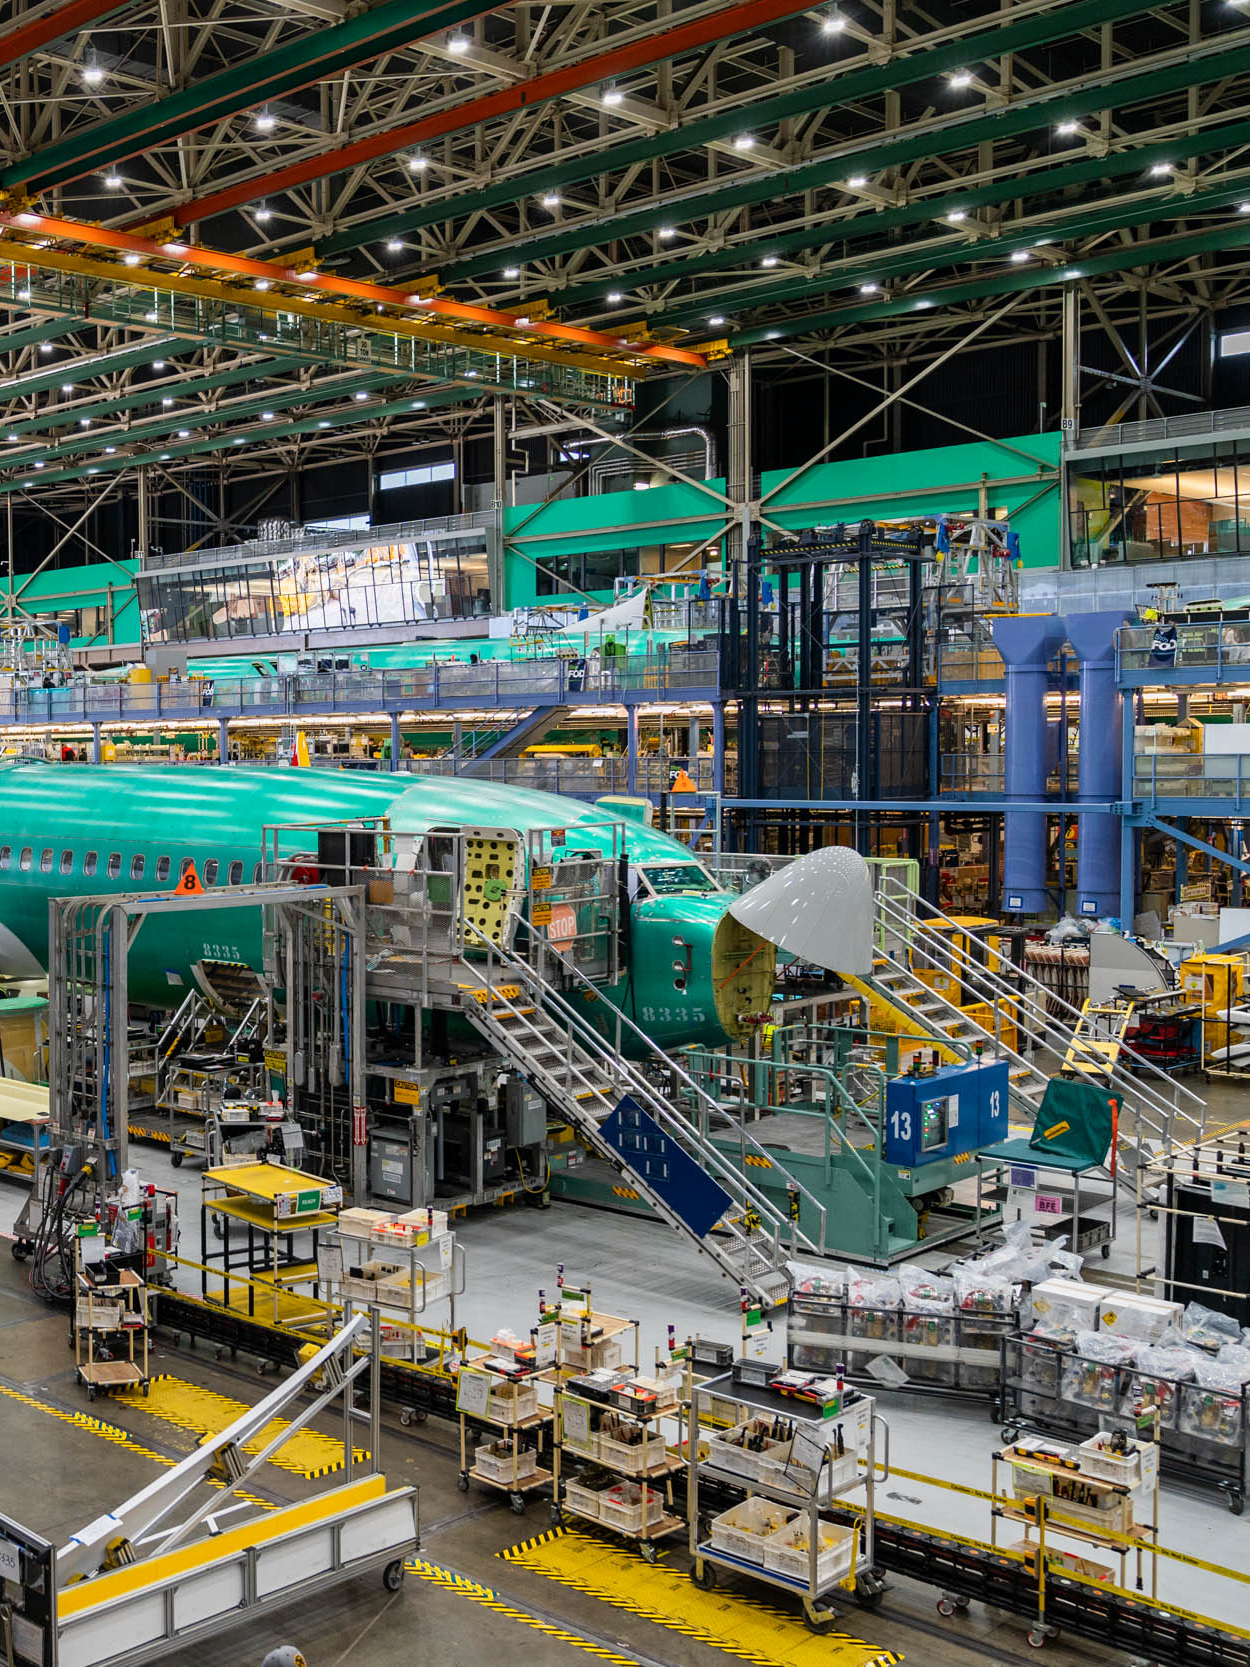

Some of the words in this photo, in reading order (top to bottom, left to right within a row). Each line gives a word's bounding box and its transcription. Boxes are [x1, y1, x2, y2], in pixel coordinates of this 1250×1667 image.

[1063, 419, 1072, 429] B9
[568, 670, 584, 678] FOD
[184, 875, 195, 890] 8
[550, 916, 574, 940] STOP
[203, 944, 240, 960] 8335
[642, 1007, 705, 1023] 8335
[395, 1080, 419, 1092] CAUTION
[990, 1090, 999, 1118] 13
[891, 1111, 911, 1140] 13
[1040, 1202, 1056, 1210] BFE
[1134, 1540, 1156, 1551] Caution
[1132, 1593, 1155, 1605] Caution
